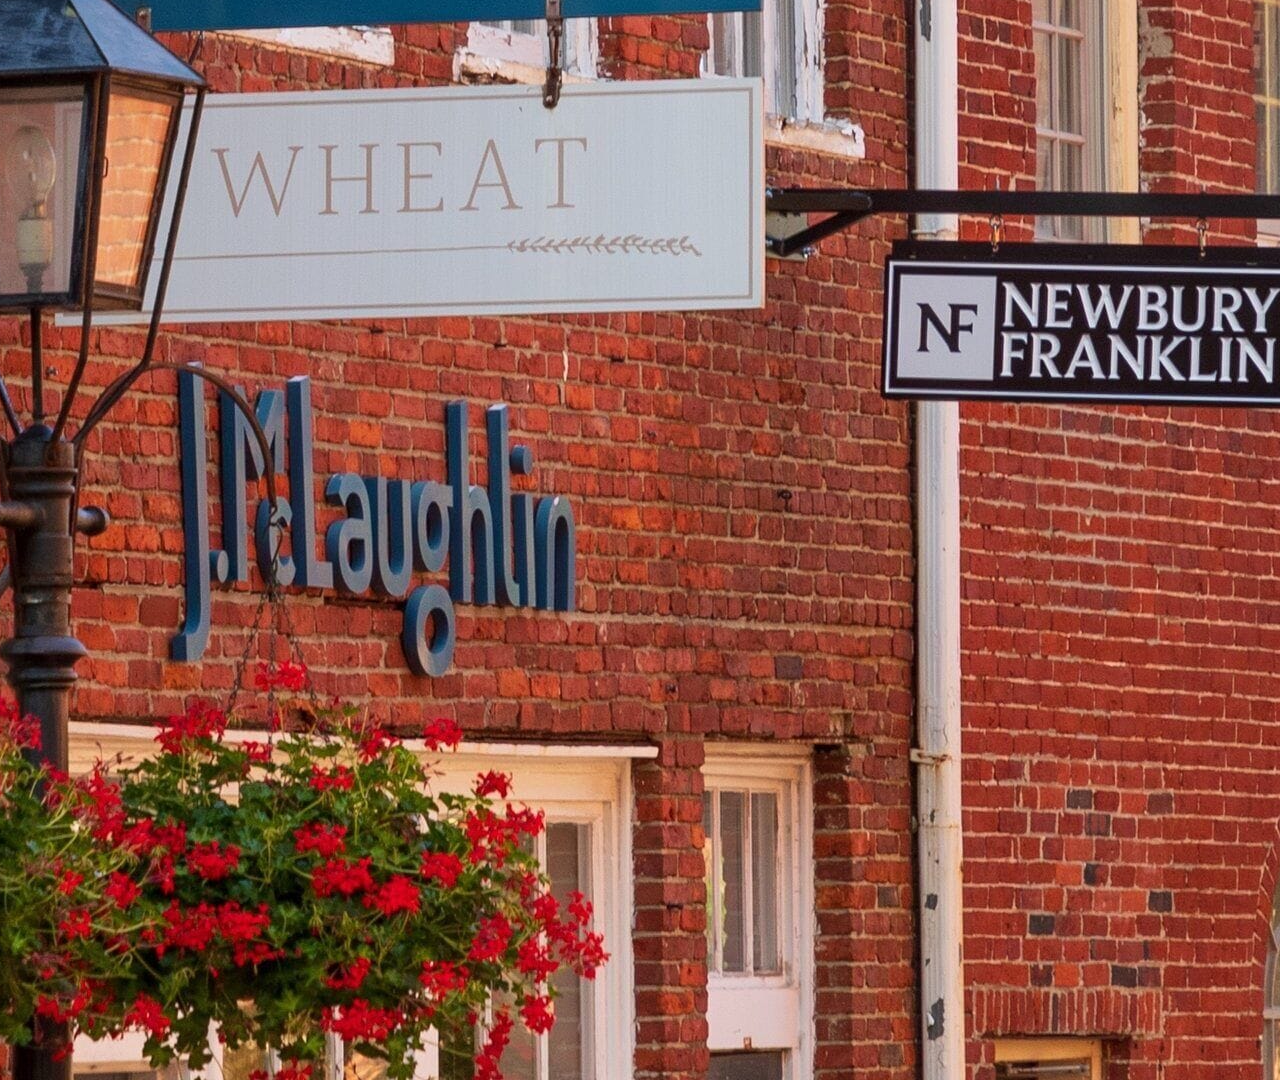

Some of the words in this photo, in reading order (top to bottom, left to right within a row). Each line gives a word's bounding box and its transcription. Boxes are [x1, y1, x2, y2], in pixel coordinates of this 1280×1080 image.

[211, 137, 588, 218] WHEAT
[916, 302, 979, 354] NF
[999, 331, 1277, 384] FRANKLIN
